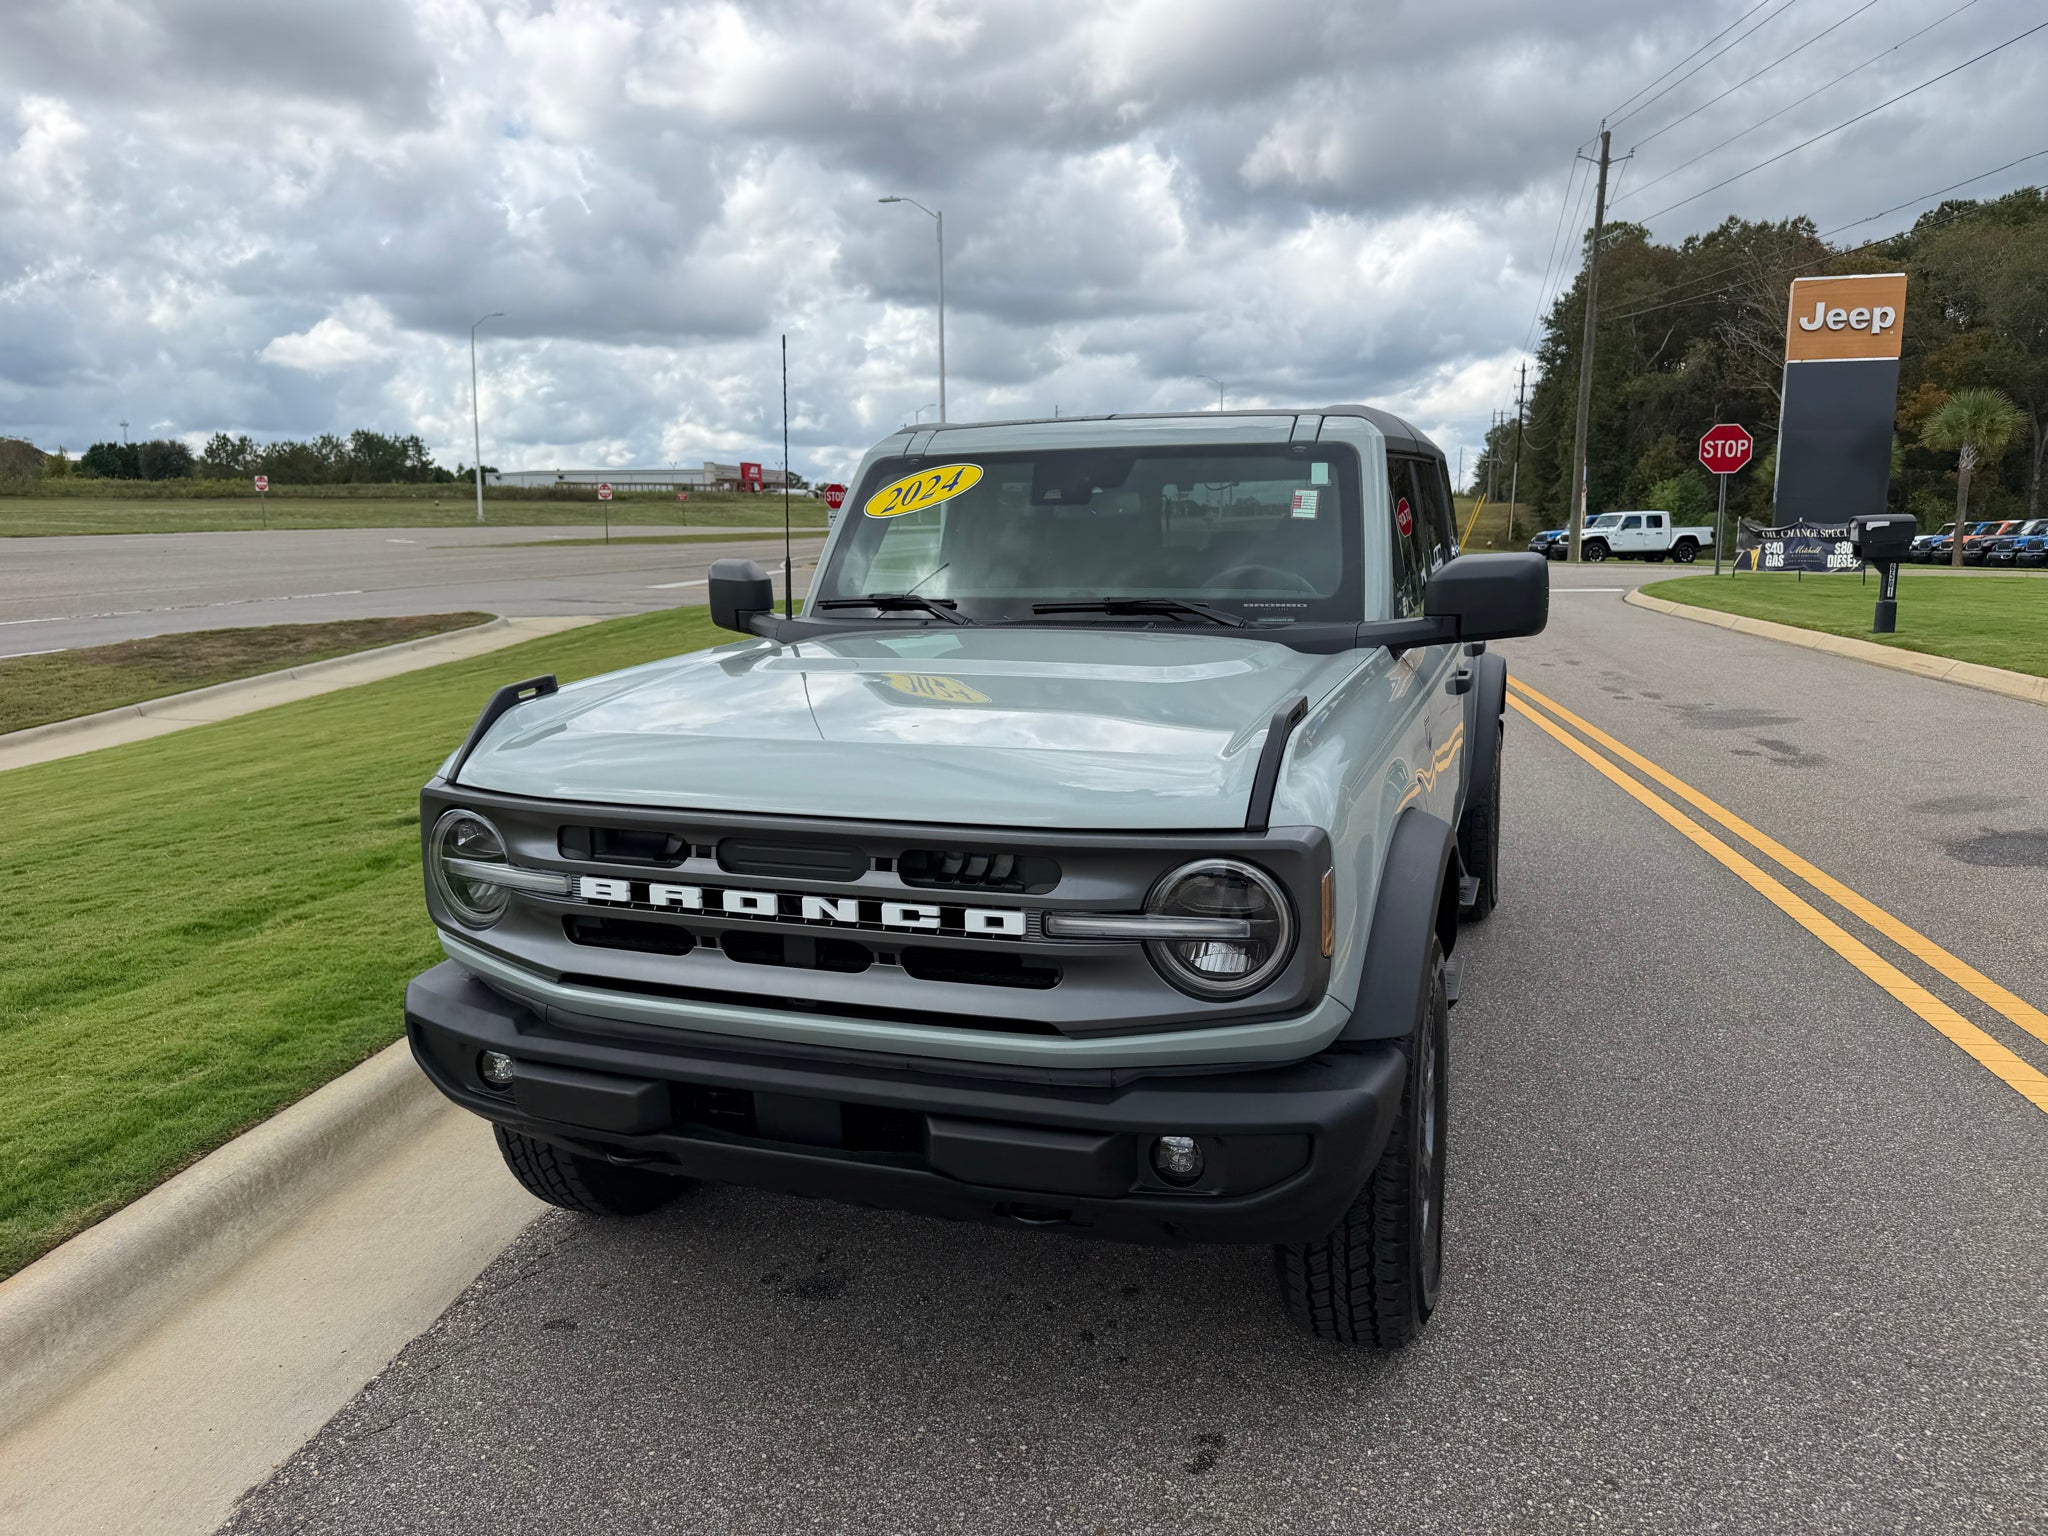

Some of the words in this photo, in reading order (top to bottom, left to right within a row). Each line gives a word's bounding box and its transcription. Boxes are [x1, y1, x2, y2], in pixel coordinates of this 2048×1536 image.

[1799, 301, 1896, 335] Jeep
[1703, 439, 1749, 459] STOP
[826, 491, 846, 502] STOP
[880, 467, 966, 514] 2024
[1762, 529, 1780, 538] OIL
[1780, 528, 1820, 538] CHANGE
[1820, 528, 1850, 538] SPECI
[1765, 541, 1784, 554] $40
[1834, 541, 1853, 554] $80
[1765, 554, 1785, 567] GAS
[579, 876, 1027, 936] BRONCO
